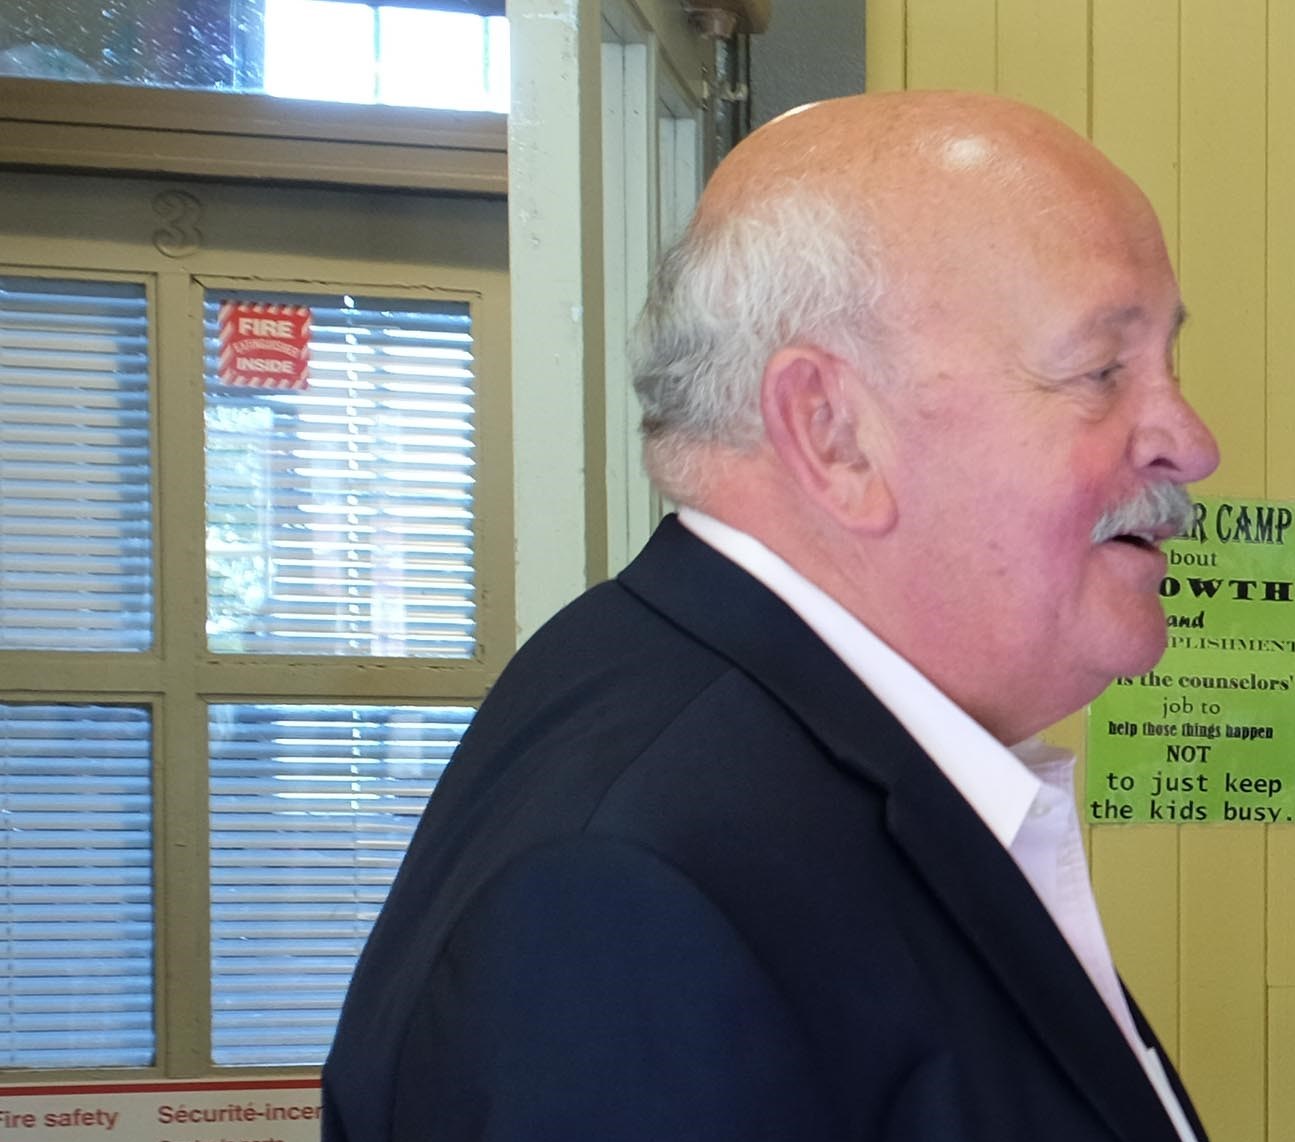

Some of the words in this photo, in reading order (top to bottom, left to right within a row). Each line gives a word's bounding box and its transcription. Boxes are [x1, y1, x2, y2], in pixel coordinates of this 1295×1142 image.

[238, 316, 296, 340] FIRE
[236, 356, 296, 375] INSIDE
[1216, 504, 1293, 545] CAMP
[1167, 610, 1205, 628] and
[1140, 670, 1174, 688] the
[1177, 673, 1294, 691] counselors'
[1162, 696, 1194, 719] job
[1201, 701, 1221, 715] to
[1108, 721, 1138, 738] help
[1142, 722, 1177, 737] those
[1182, 722, 1221, 740] things
[1225, 724, 1273, 740] happen
[1166, 744, 1212, 763] NOT
[1106, 773, 1135, 792] to
[1151, 771, 1208, 796] just
[1225, 773, 1282, 798] keep
[1090, 800, 1134, 820] the
[1150, 801, 1208, 821] kids
[1224, 801, 1294, 823] busy.
[43, 1106, 119, 1131] safety
